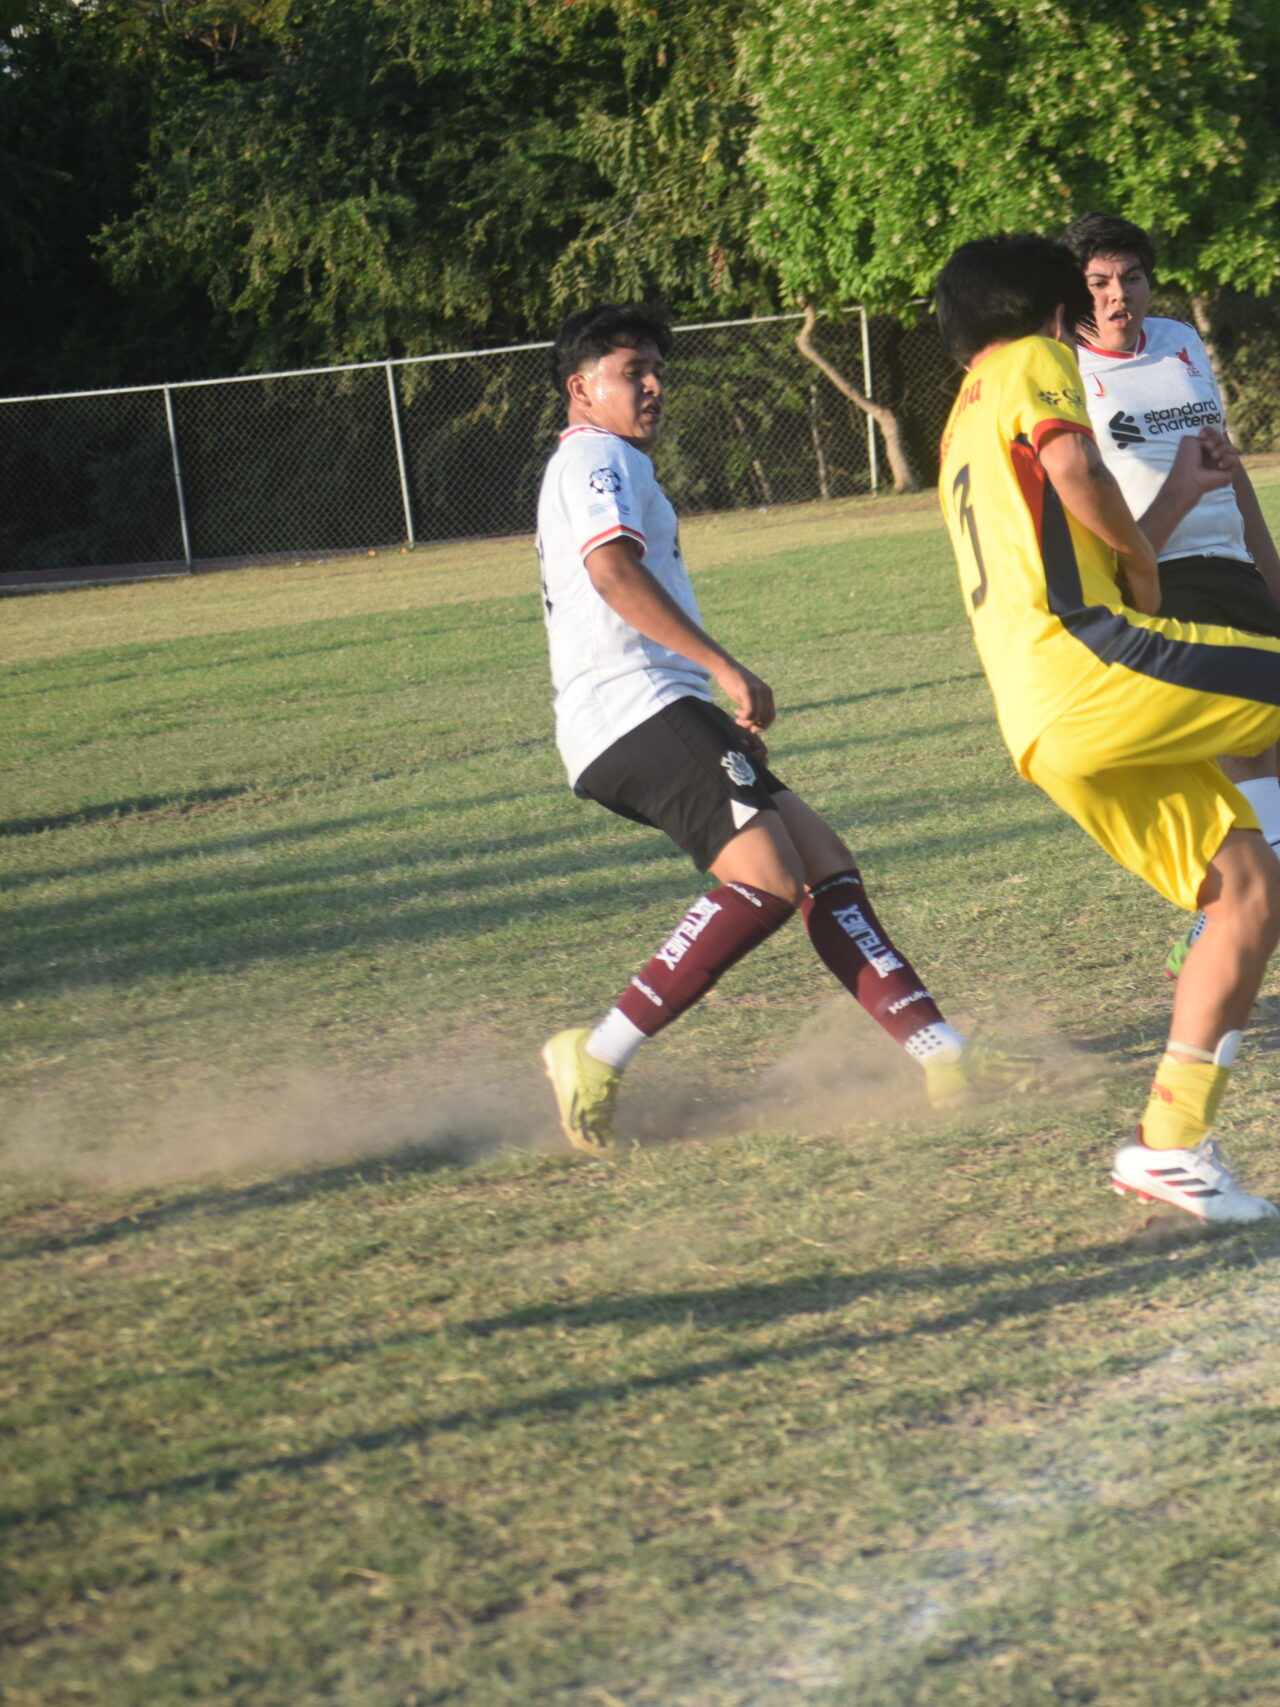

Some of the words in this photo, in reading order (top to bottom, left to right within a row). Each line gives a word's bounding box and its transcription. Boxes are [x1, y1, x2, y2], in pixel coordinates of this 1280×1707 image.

[1144, 400, 1217, 424] standard
[1148, 413, 1221, 435] chartered
[656, 912, 709, 971] TELMEX
[832, 904, 888, 963] TELMEX
